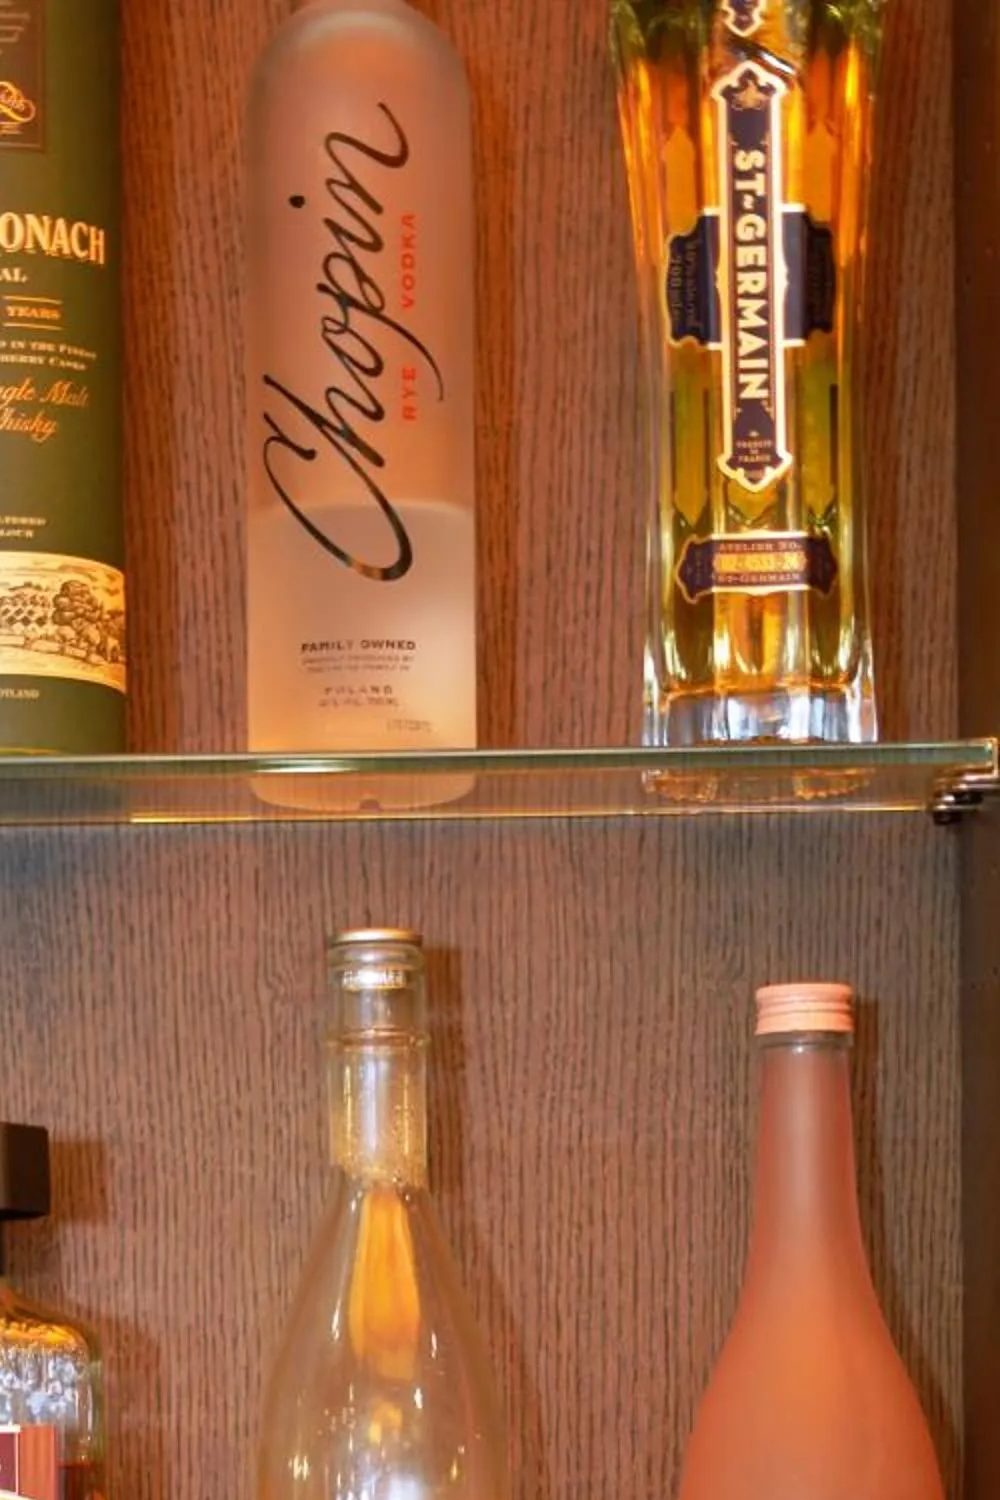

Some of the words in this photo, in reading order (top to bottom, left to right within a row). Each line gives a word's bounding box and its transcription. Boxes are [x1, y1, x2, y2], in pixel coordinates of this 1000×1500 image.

[401, 213, 417, 309] VODKA
[6, 305, 61, 320] YEARS
[263, 101, 444, 582] Chopin
[40, 379, 90, 407] Malt
[402, 367, 418, 421] RYE
[301, 639, 354, 653] FAMILY
[360, 638, 417, 652] OWNED
